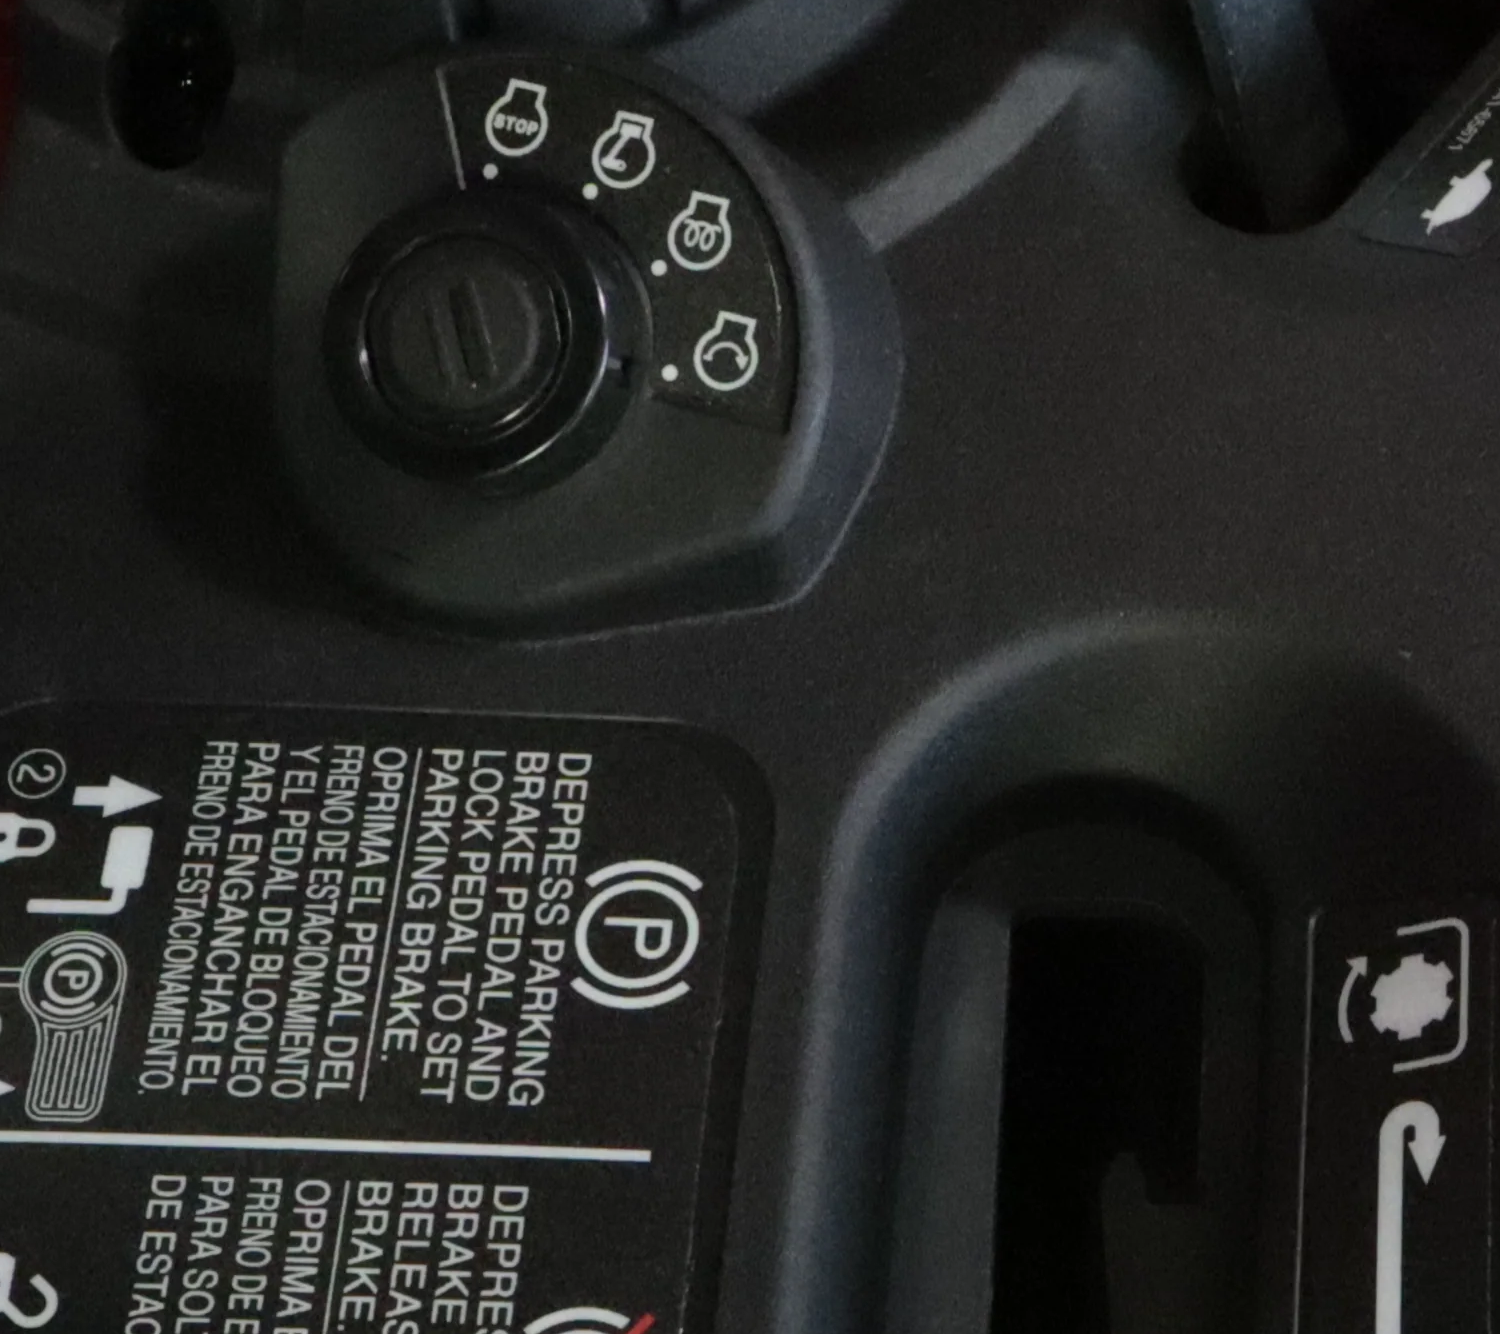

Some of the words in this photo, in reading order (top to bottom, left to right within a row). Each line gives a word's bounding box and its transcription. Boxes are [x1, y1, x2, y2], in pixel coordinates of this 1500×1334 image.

[492, 112, 540, 137] STOP
[191, 740, 240, 820] FRENO
[232, 741, 282, 826] PARA
[279, 769, 319, 804] EL
[289, 744, 324, 764] Y
[319, 744, 366, 825] FRENO
[460, 749, 508, 842] LOCK
[183, 824, 222, 857] DE
[312, 829, 351, 863] DE
[354, 746, 409, 869] OPRIMA
[405, 747, 465, 910] PARKING
[498, 750, 551, 875] BRAKE
[534, 752, 593, 926] DEPRESS
[261, 809, 311, 901] PEDAL
[346, 875, 387, 915] EL
[190, 832, 264, 1044] ENGANCHAR
[253, 906, 294, 947] DE
[439, 850, 492, 965] PEDAL
[476, 886, 529, 1012] PEDAL
[137, 862, 215, 1095] ESTACIONAMIENTO.
[269, 868, 345, 1100] ESTACIONAMIENTO
[326, 921, 379, 1028] PEDAL
[380, 921, 437, 1062] BRAKE.
[431, 972, 473, 1022] TO
[225, 953, 285, 1098] BLOQUEO
[314, 1035, 360, 1101] DEL
[419, 1031, 463, 1105] SET
[464, 1017, 508, 1102] AND
[506, 938, 566, 1107] PARKING
[180, 1053, 223, 1096] EL
[145, 1173, 188, 1220] DE
[186, 1175, 236, 1262] PARA
[234, 1177, 284, 1268] FRENO
[227, 1274, 268, 1312] DE
[275, 1178, 332, 1318] OPRIMA
[336, 1180, 394, 1332] BRAKE.
[430, 1183, 485, 1325] BRAKE
